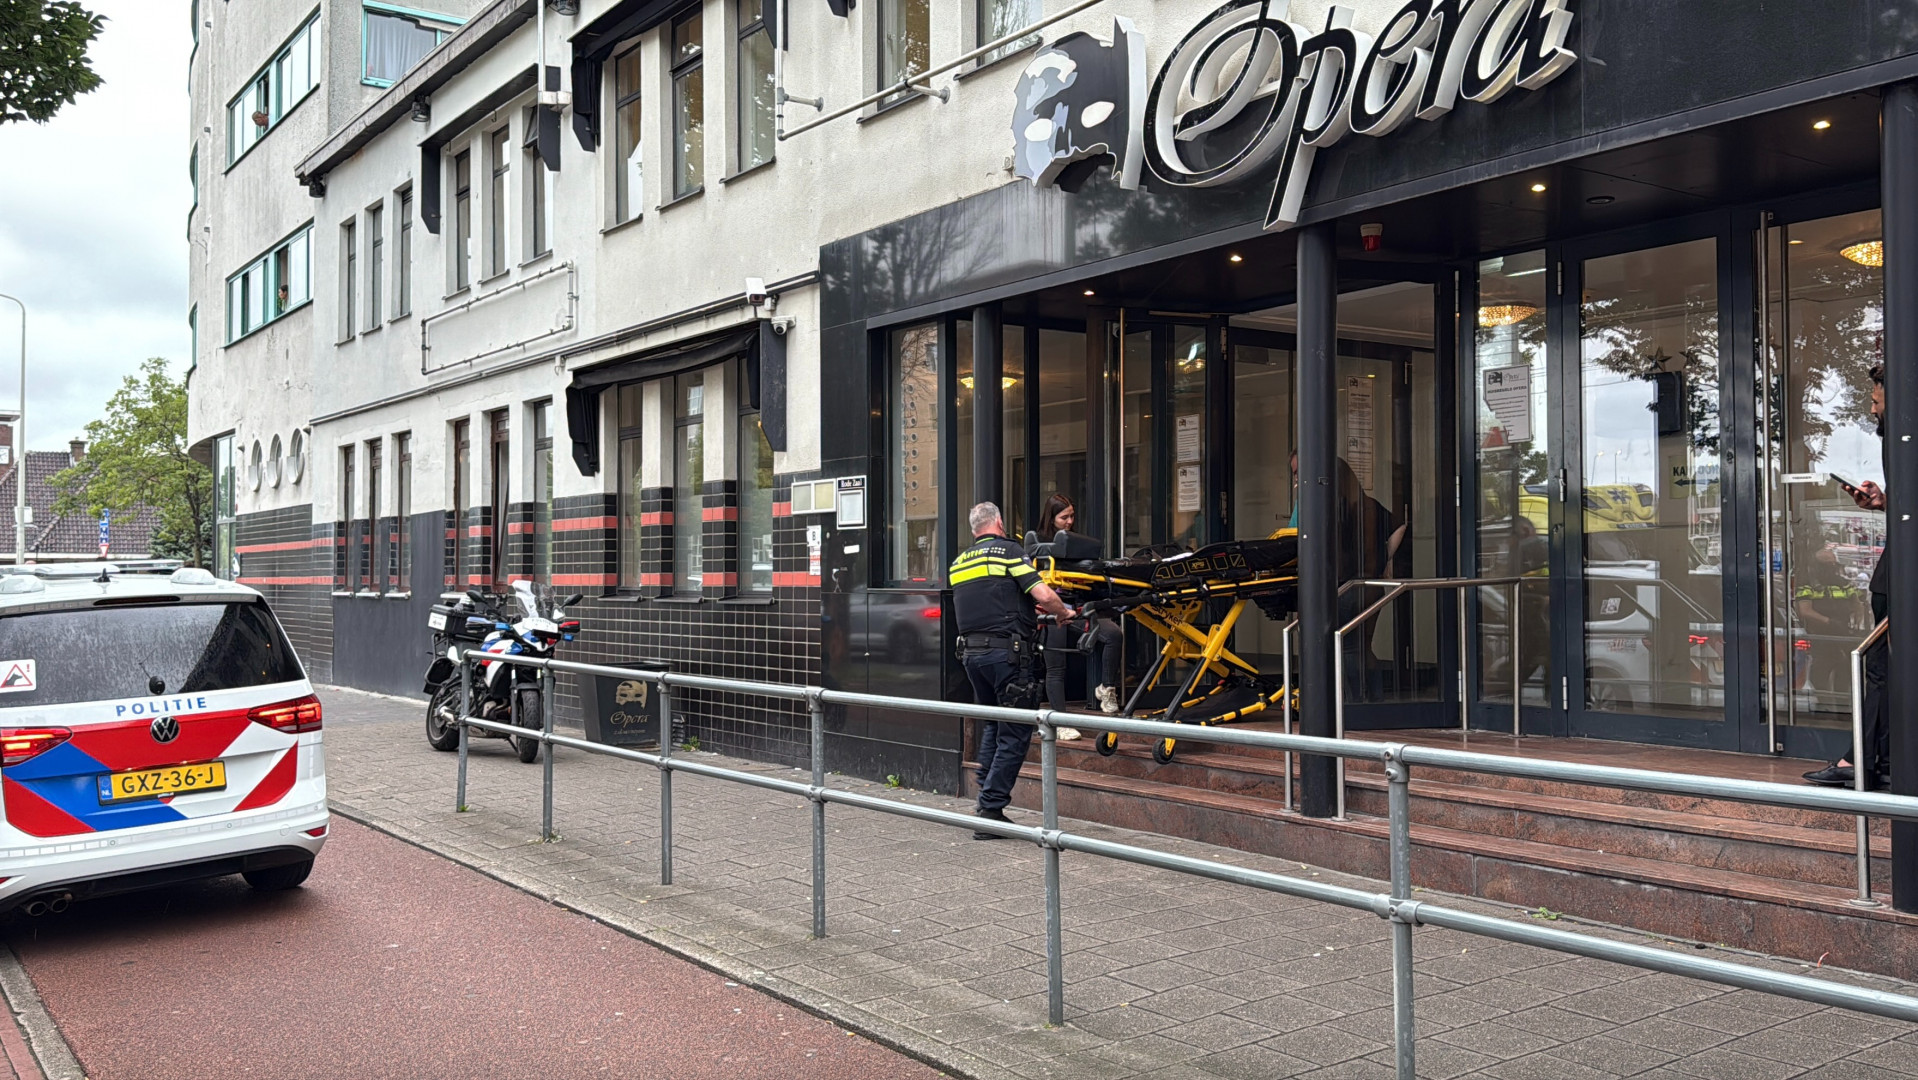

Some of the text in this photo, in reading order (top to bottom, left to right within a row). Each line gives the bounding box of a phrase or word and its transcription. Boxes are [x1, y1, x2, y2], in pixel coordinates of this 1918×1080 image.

[1143, 0, 1576, 231] Opera
[115, 697, 207, 717] POLITIE
[610, 711, 650, 728] Opera
[121, 766, 214, 794] GXZ-36-J
